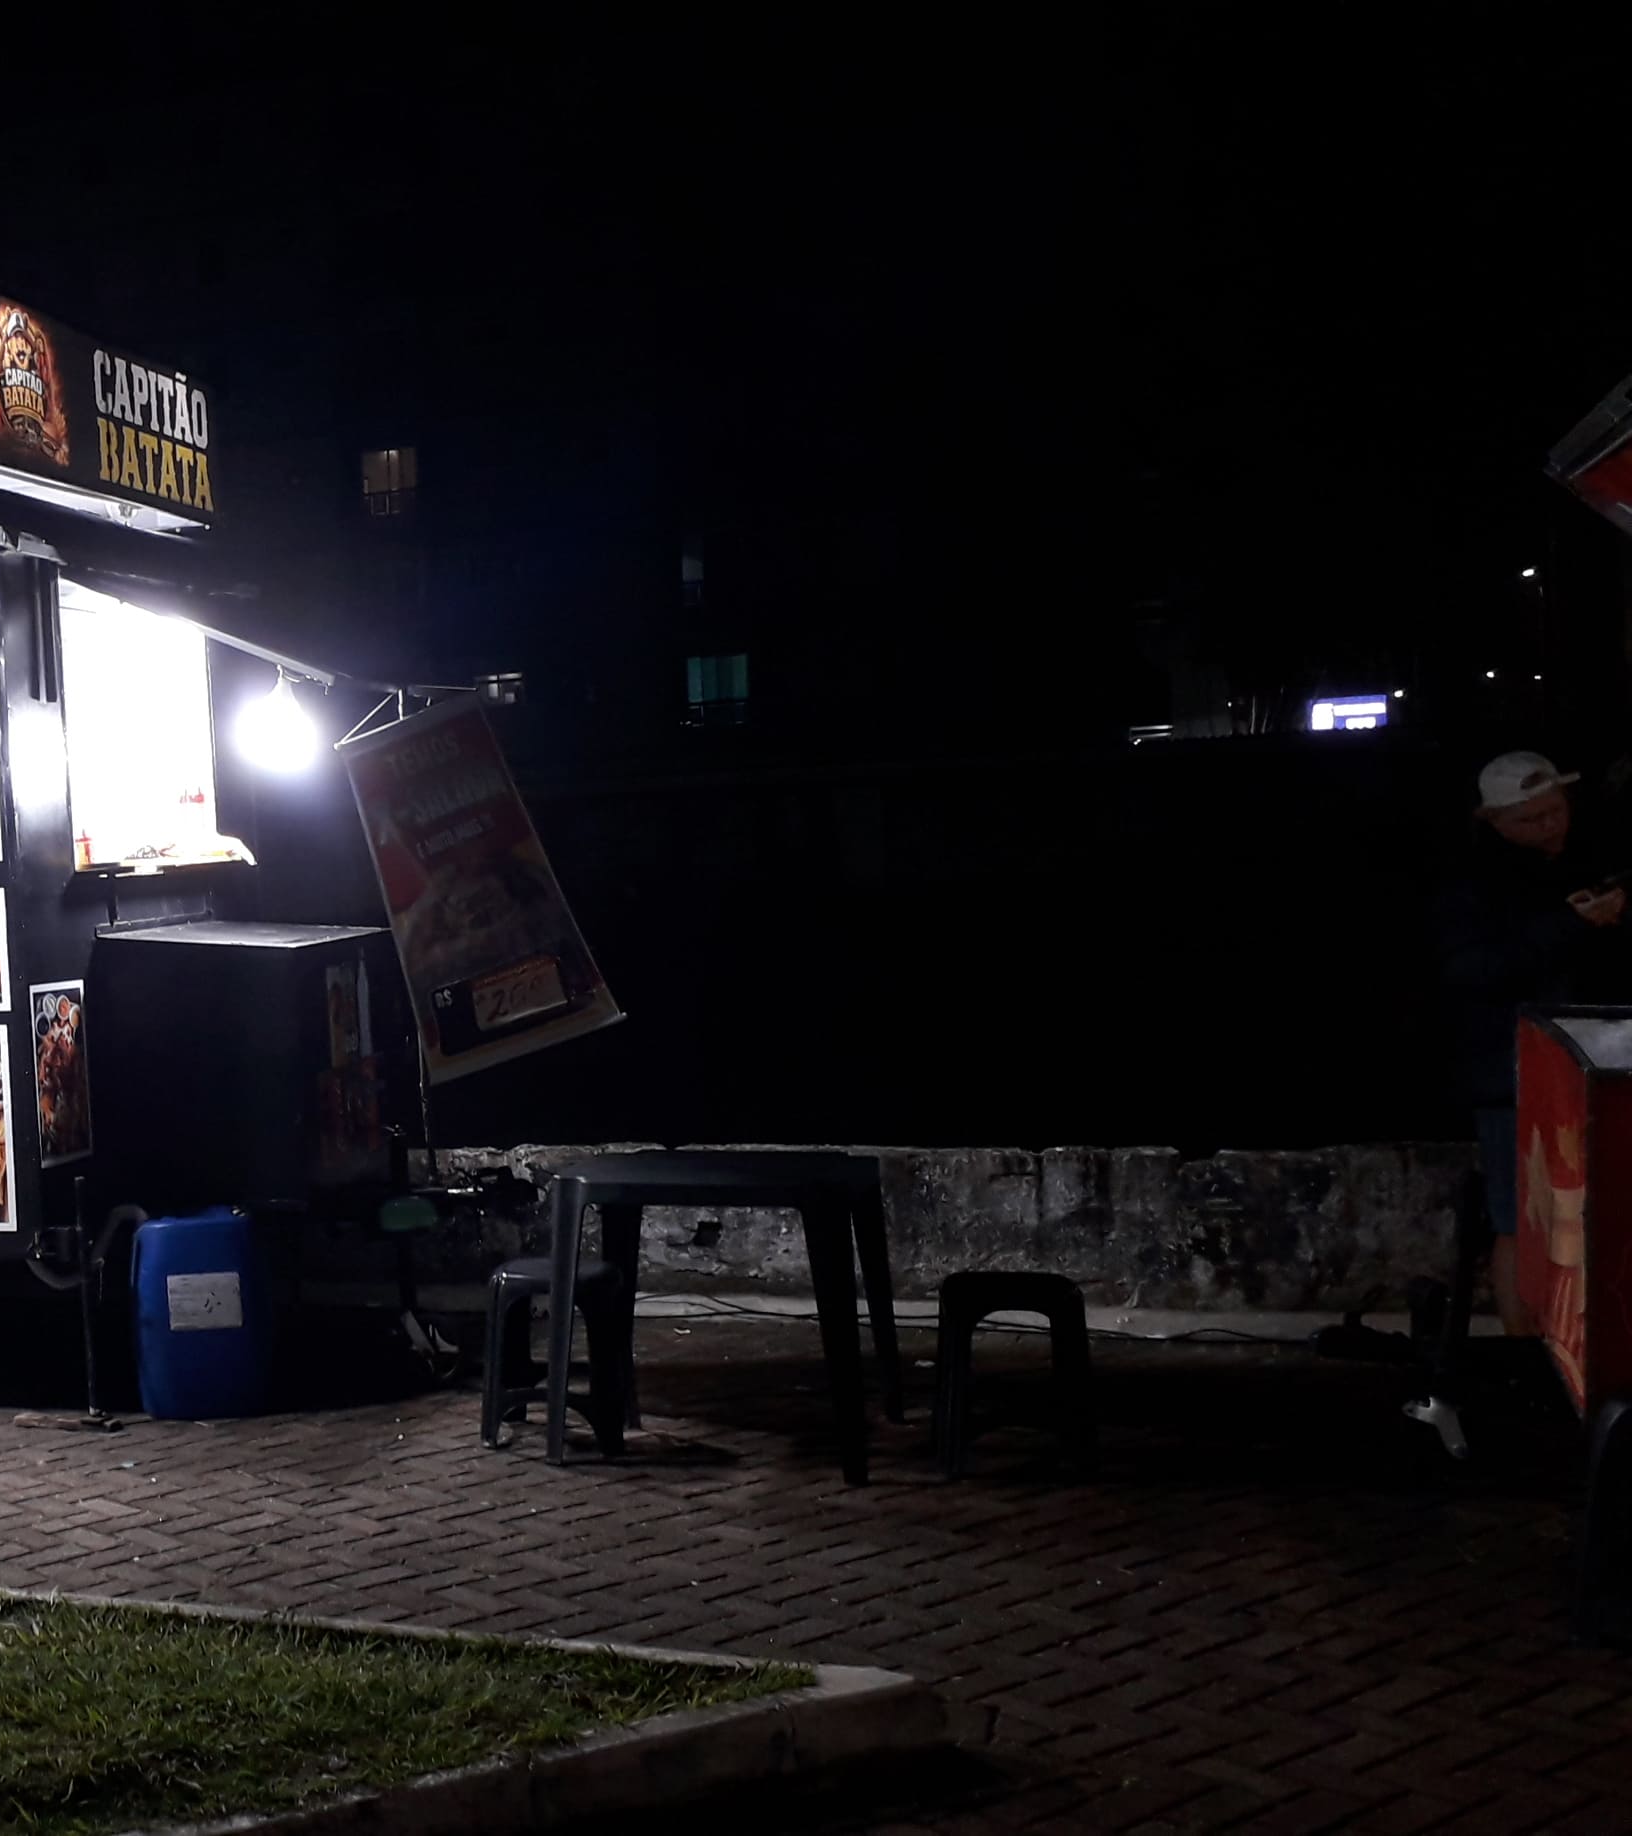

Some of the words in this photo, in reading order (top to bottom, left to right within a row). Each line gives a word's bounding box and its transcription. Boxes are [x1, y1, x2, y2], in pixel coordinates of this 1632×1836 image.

[2, 387, 45, 418] BATATA
[5, 367, 43, 395] CAPITÃO
[93, 349, 208, 449] CAPITÃO
[97, 417, 214, 512] BATATA
